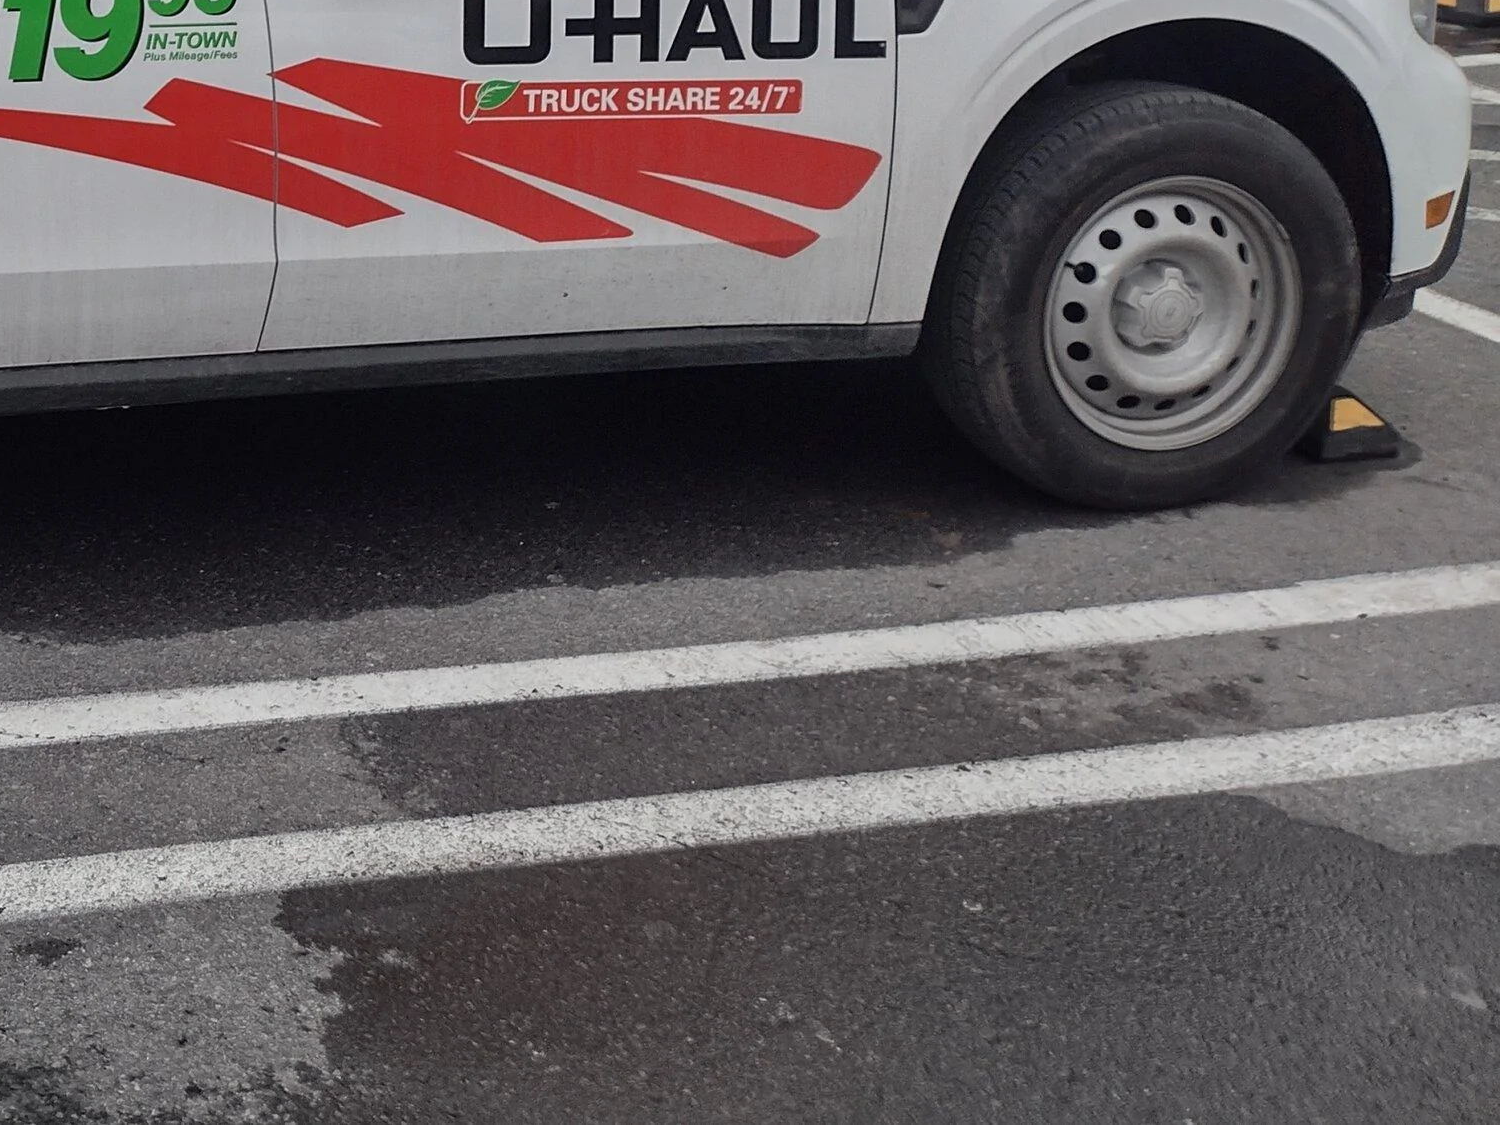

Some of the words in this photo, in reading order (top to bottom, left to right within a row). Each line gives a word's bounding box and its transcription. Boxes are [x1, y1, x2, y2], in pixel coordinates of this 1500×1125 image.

[146, 31, 238, 50] IN-TOWN
[143, 52, 167, 62] Plus
[169, 50, 238, 62] Mileage/Fees
[523, 88, 619, 113] TRUCK
[626, 86, 721, 111] SHARE
